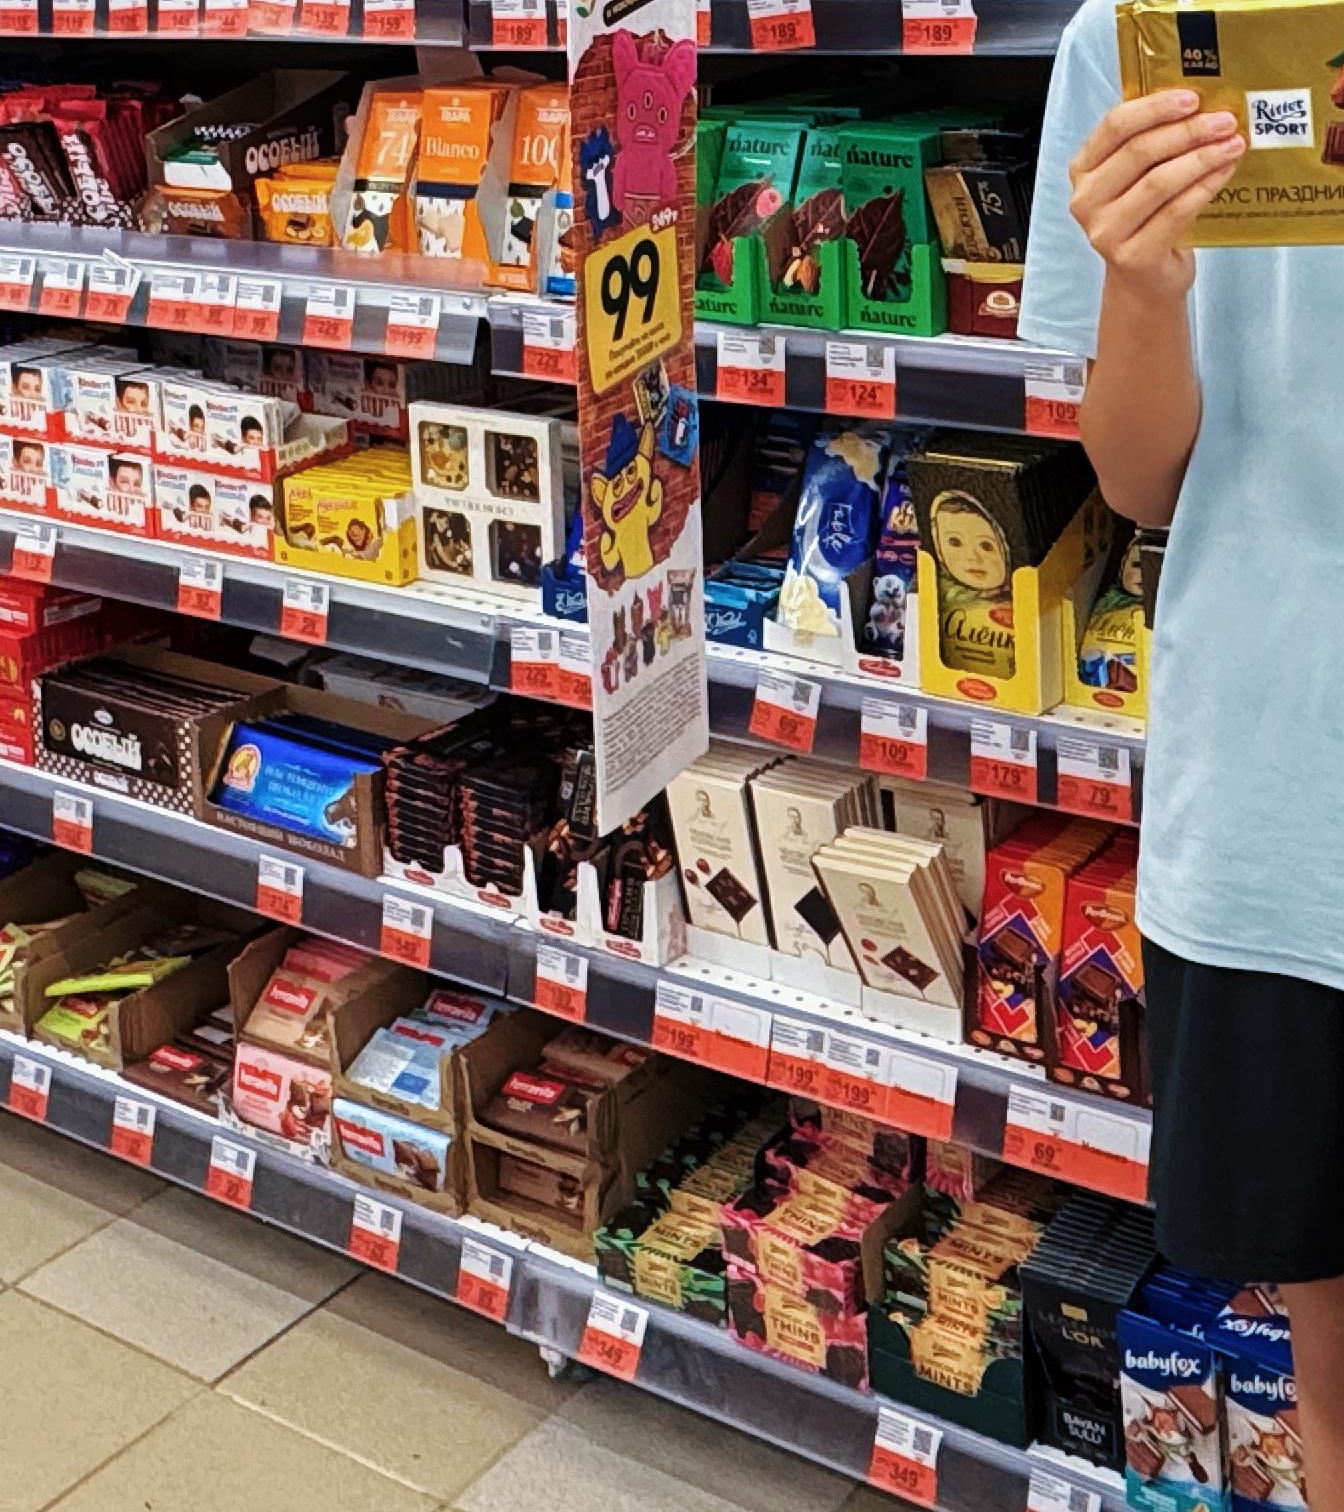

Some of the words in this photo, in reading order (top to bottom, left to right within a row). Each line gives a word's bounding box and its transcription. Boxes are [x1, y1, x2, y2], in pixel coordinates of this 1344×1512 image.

[1253, 99, 1306, 123] Ritter
[1255, 123, 1306, 135] SPORT
[426, 136, 480, 160] Blanco
[1209, 186, 1250, 203] КУС
[601, 239, 660, 342] 99
[695, 298, 737, 315] ature
[71, 722, 142, 770] ОСОБЫЙ
[1125, 1350, 1201, 1377] babyfox
[917, 1364, 979, 1394] MINTS
[1231, 1374, 1296, 1402] babyfo
